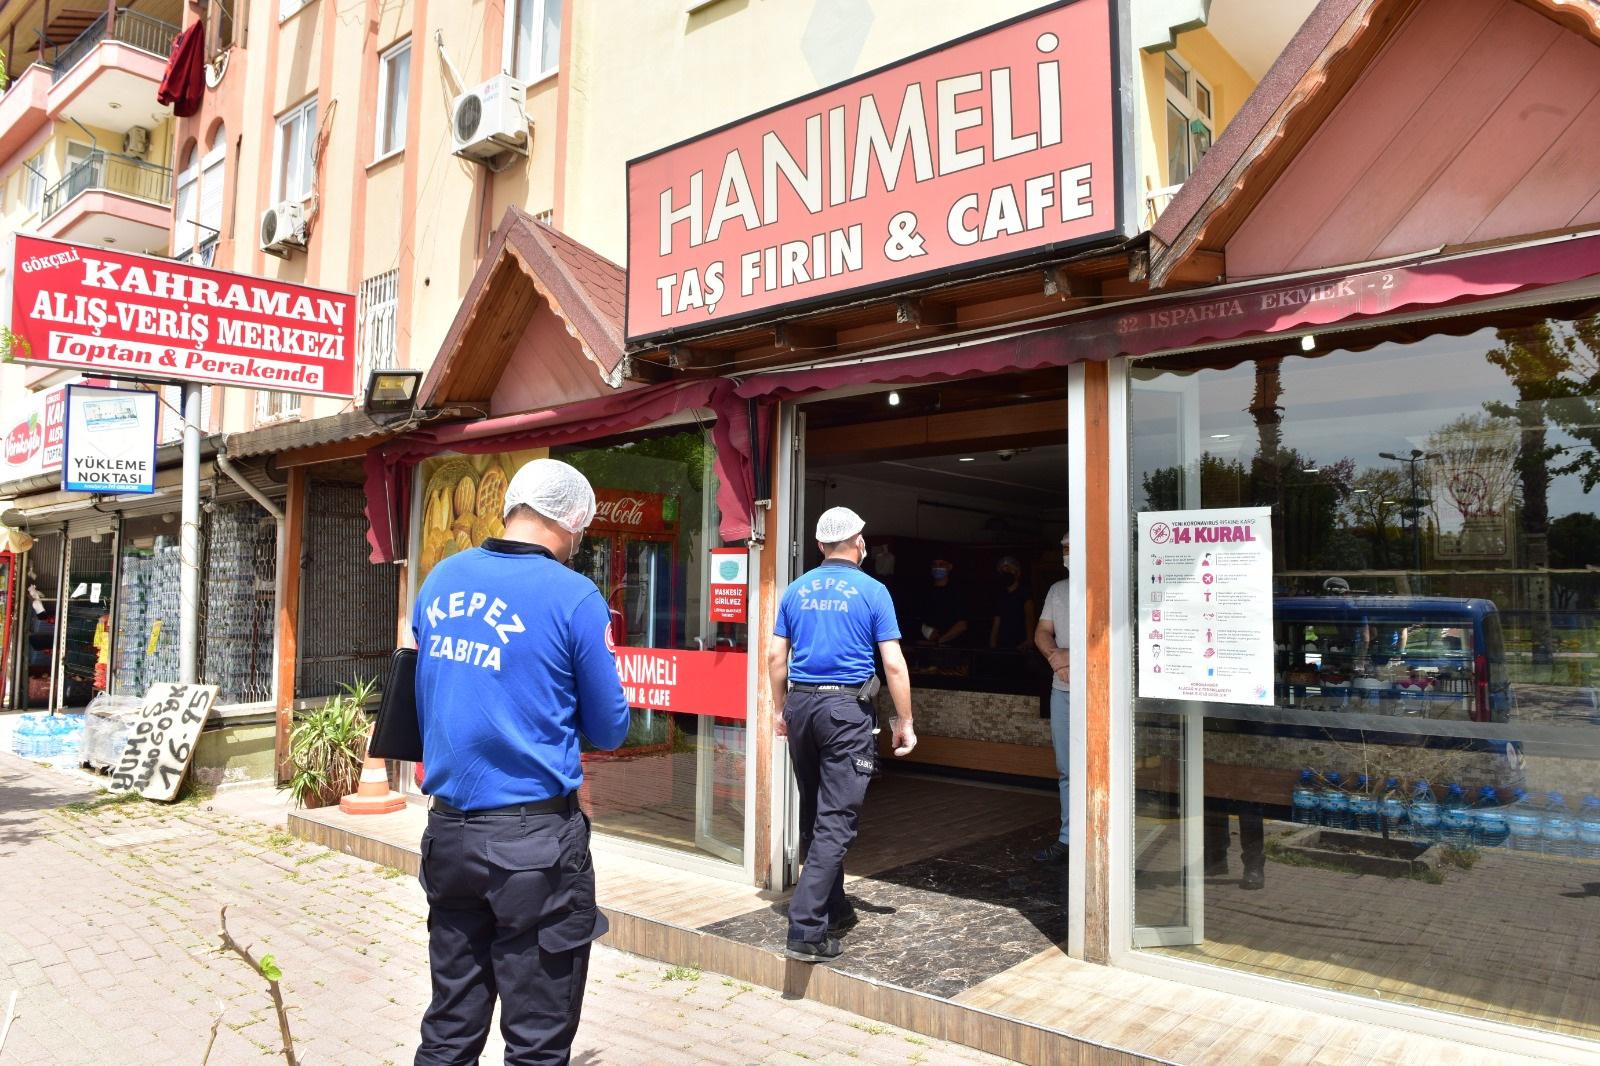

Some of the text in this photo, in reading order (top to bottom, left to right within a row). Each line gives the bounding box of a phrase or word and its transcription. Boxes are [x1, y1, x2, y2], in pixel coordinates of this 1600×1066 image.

[658, 31, 1062, 257] HANIMELİ
[656, 162, 1094, 315] TAŞ FIRIN & CAFE
[21, 246, 80, 273] GÖKÇELİ
[81, 258, 346, 326] KAHRAMAN
[1119, 317, 1138, 334] 32
[1149, 299, 1244, 328] ISPARTA
[1260, 280, 1356, 311] EKMEK
[1382, 274, 1394, 291] 2
[29, 289, 345, 361] ALIŞ-VERİŞ MERKEZİ
[55, 334, 319, 384] Toptan & Perakende
[74, 456, 147, 471] YÜKLEME
[78, 472, 142, 484] NOKTASI
[1172, 525, 1256, 544] 14 KURAL
[798, 577, 859, 599] KEPEZ
[426, 591, 526, 645] KEPEZ
[800, 598, 849, 613] ZABITA
[429, 634, 501, 671] ZABITA
[615, 654, 677, 686] ANIMELİ
[638, 687, 646, 704] &
[648, 688, 671, 707] CAFE
